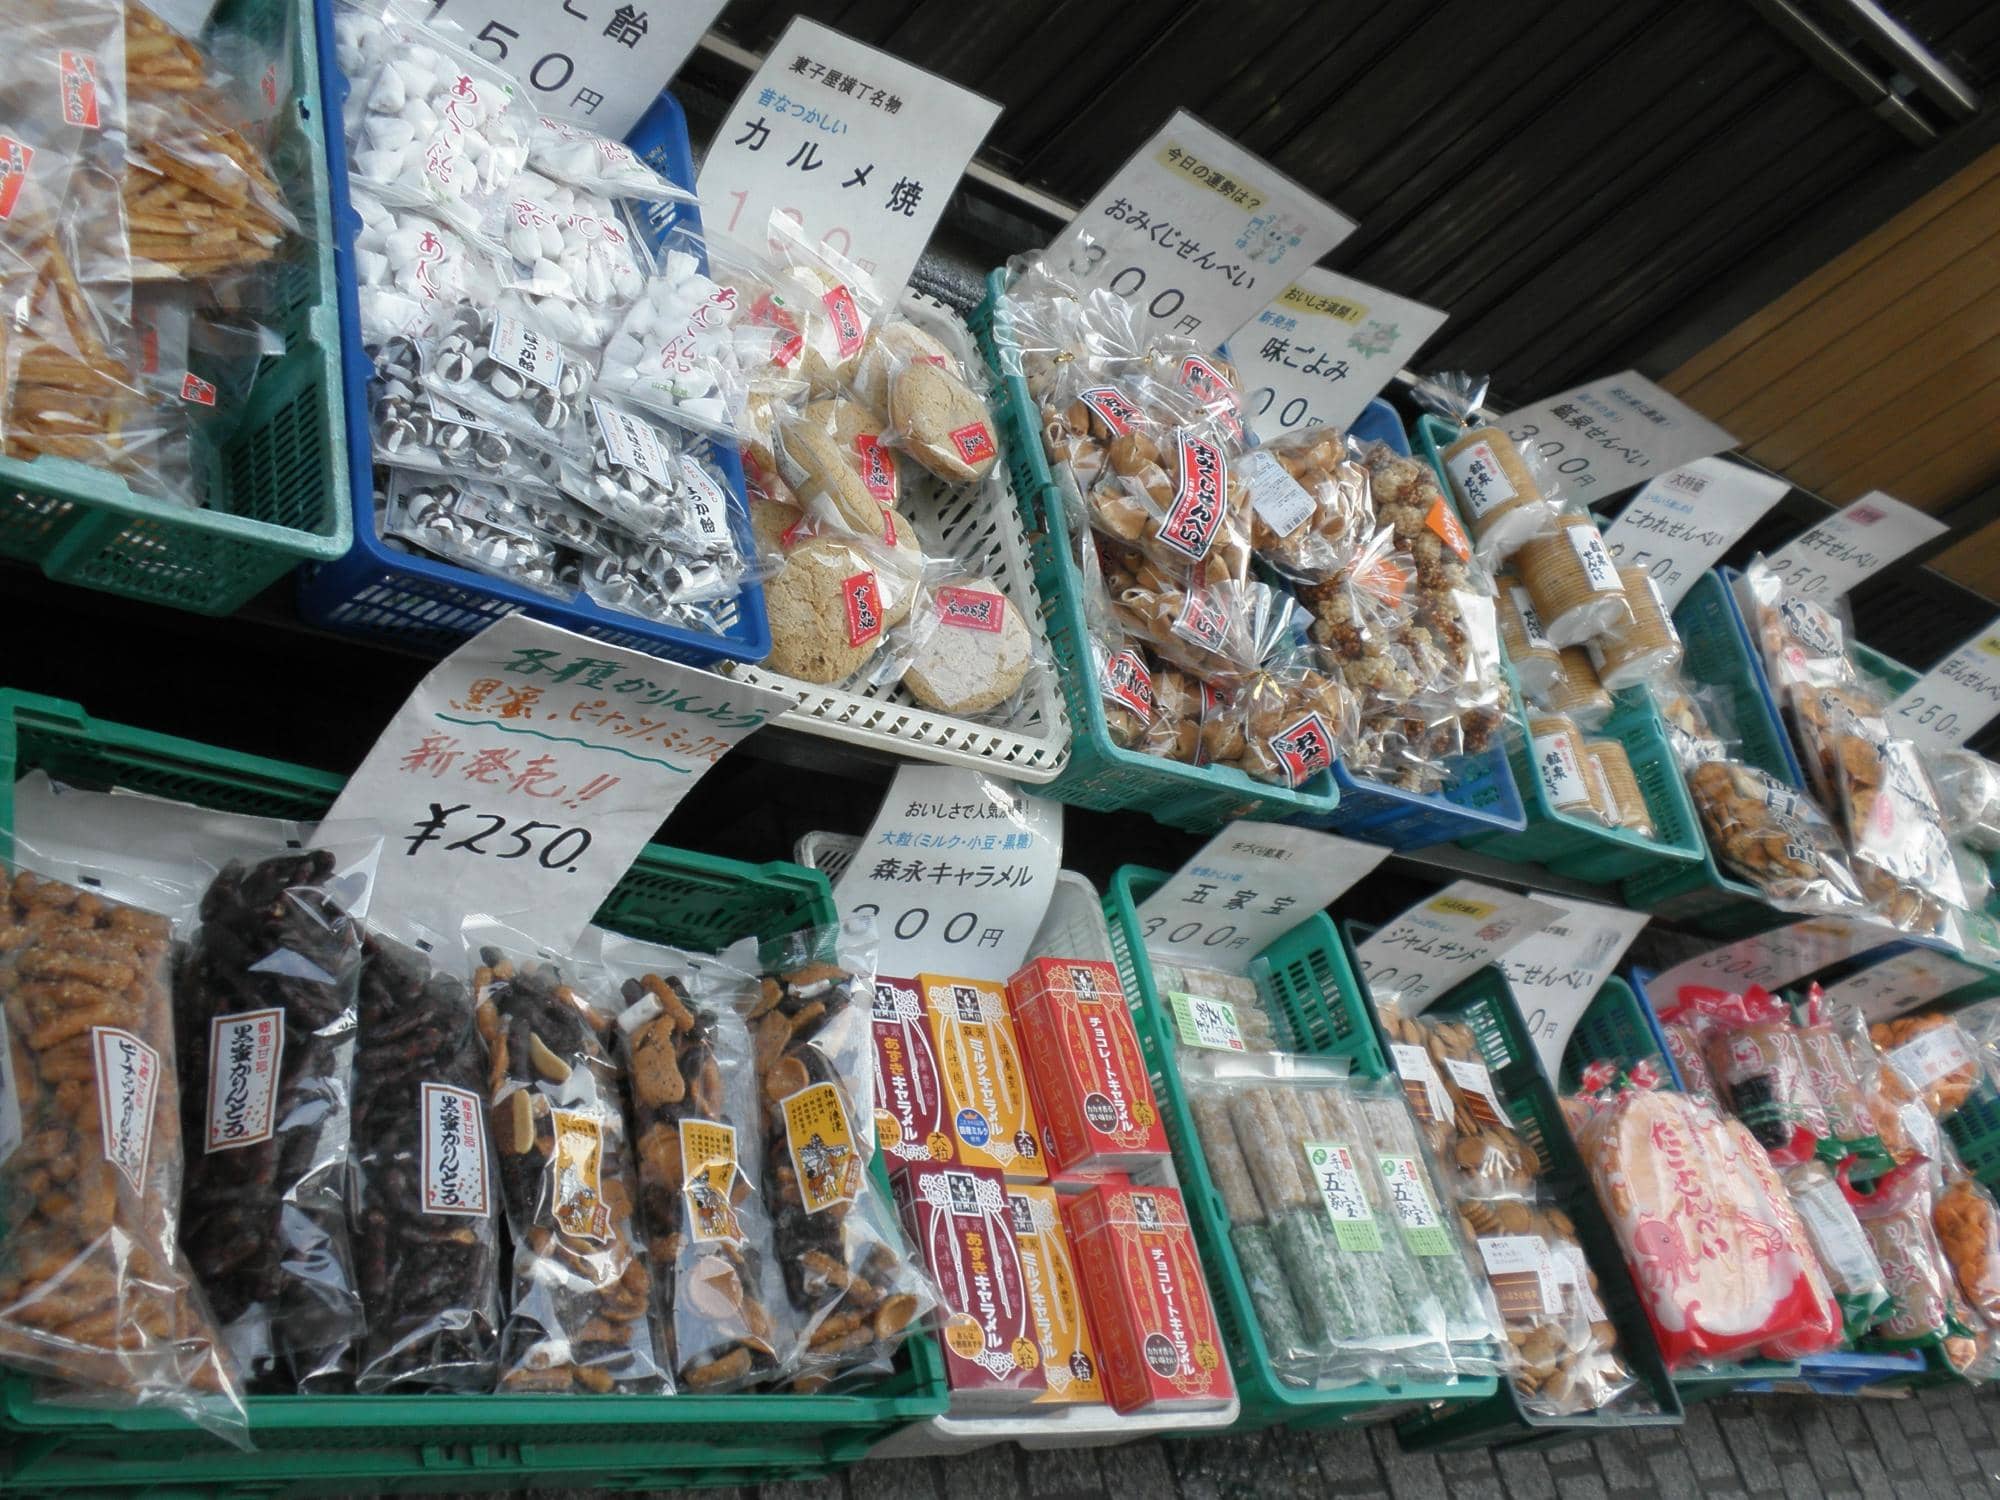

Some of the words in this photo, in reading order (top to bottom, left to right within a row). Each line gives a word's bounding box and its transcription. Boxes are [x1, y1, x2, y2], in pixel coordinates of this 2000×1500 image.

[788, 56, 904, 114] 菓子屋横丁名物
[757, 88, 848, 135] 昔なつかしい
[735, 117, 924, 217] カルメ焼
[1166, 147, 1262, 210] 今日の運勢は?
[1104, 198, 1256, 290] おみくじせんべい
[1257, 310, 1299, 332] 新発売
[1259, 336, 1350, 383] 味ごよみ
[1624, 508, 1725, 548] こわれせんべい
[869, 857, 1034, 889] 森永キャラメル
[1181, 882, 1297, 916] 五家宝
[1142, 916, 1250, 950] 300円
[1382, 928, 1489, 963] ジャムサンド
[883, 1036, 919, 1141] あずきキャラメル
[968, 1038, 1004, 1136] ミルクキャラメル
[1087, 1016, 1134, 1132] チョコレートキャラメル
[930, 1132, 950, 1162] 大粒
[1015, 1130, 1037, 1161] 大粒
[1652, 1120, 1730, 1260] たこせんべい
[965, 1231, 1004, 1349] あずきキャラメル
[1022, 1251, 1058, 1358] ミルクキャラメル
[1151, 1248, 1197, 1375] チョコレートキャラメル
[1069, 1350, 1092, 1383] 大粒
